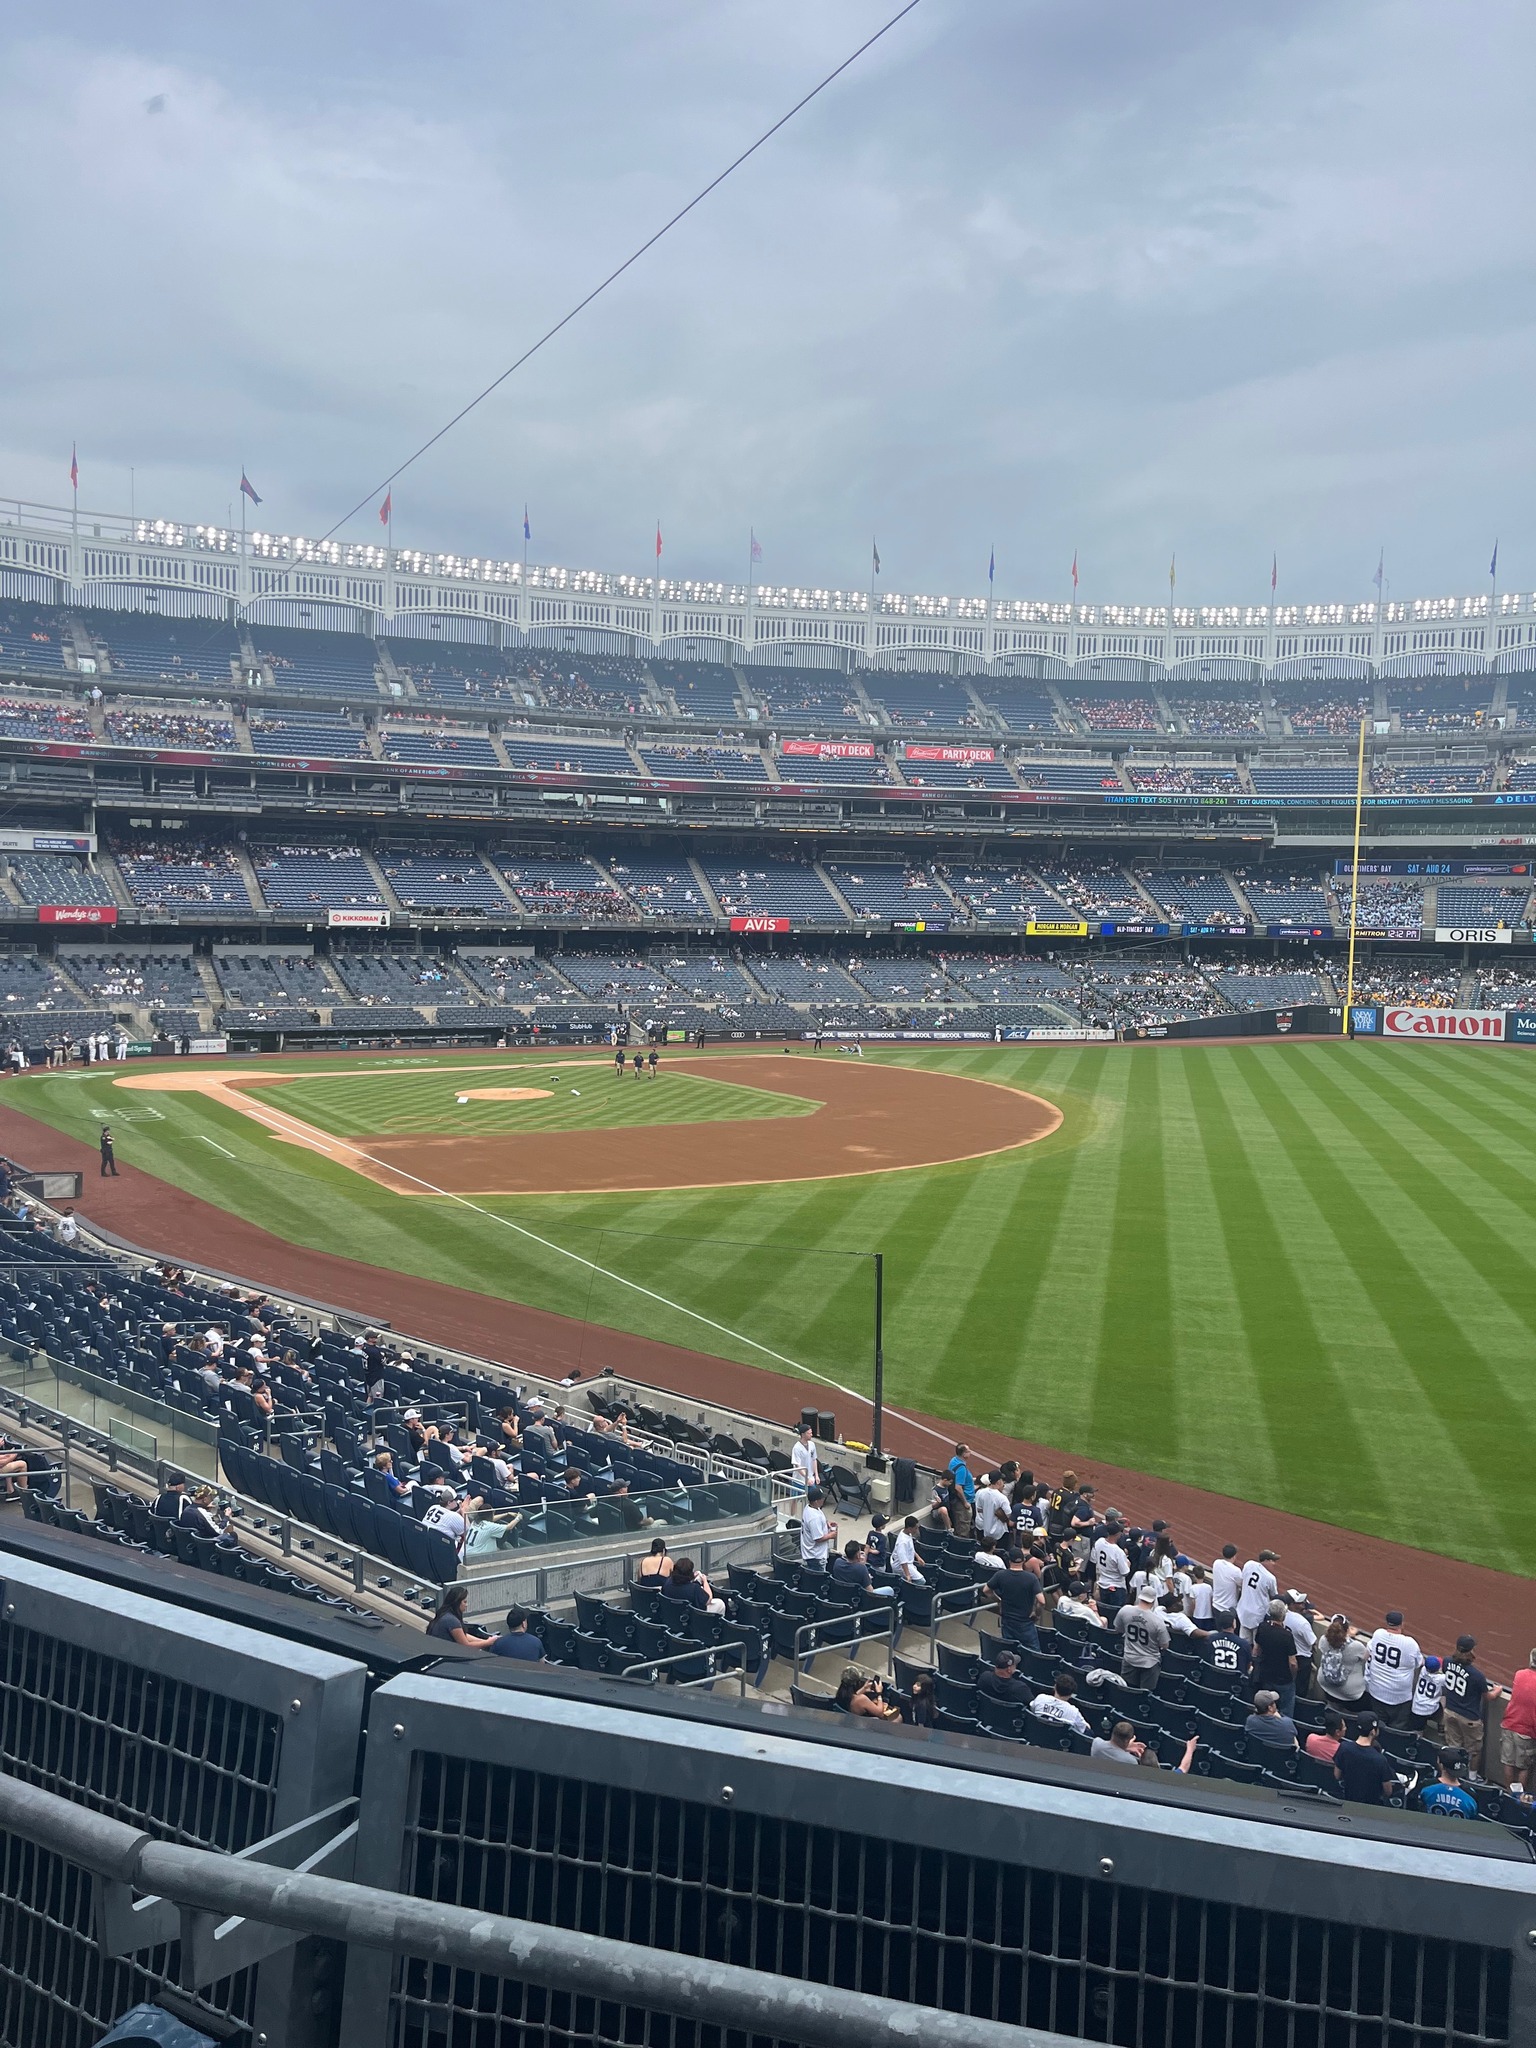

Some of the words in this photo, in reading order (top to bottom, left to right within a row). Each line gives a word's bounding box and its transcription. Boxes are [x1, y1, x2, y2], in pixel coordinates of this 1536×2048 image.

[821, 745, 846, 755] PARTY
[849, 746, 870, 756] DECK
[942, 749, 968, 759] PARTY
[971, 750, 991, 760] DECK
[1507, 795, 1536, 803] DELT
[1407, 864, 1419, 873] SAT
[1426, 864, 1439, 873] AUG
[1441, 864, 1450, 873] 24
[56, 908, 87, 921] Wendy's
[744, 919, 776, 931] AVIS
[1388, 930, 1404, 938] 12:12
[1450, 930, 1496, 941] ORIS
[1353, 1016, 1374, 1024] YORK
[1355, 1010, 1373, 1018] NEW
[1355, 1022, 1372, 1030] LIFE
[1385, 1010, 1502, 1037] Canon
[1517, 1018, 1536, 1029] Mo
[1051, 1493, 1062, 1510] 12
[1017, 1516, 1035, 1532] 22
[1100, 1550, 1107, 1567] 2
[1248, 1572, 1260, 1589] 2
[1127, 1624, 1149, 1645] 99
[1215, 1649, 1237, 1669] 23
[1375, 1642, 1401, 1669] 99
[1447, 1662, 1469, 1679] JUDGE
[1418, 1678, 1436, 1698] 99
[1446, 1670, 1467, 1697] 99
[1044, 1704, 1064, 1718] RIZZO
[1436, 1793, 1462, 1807] JUDGE
